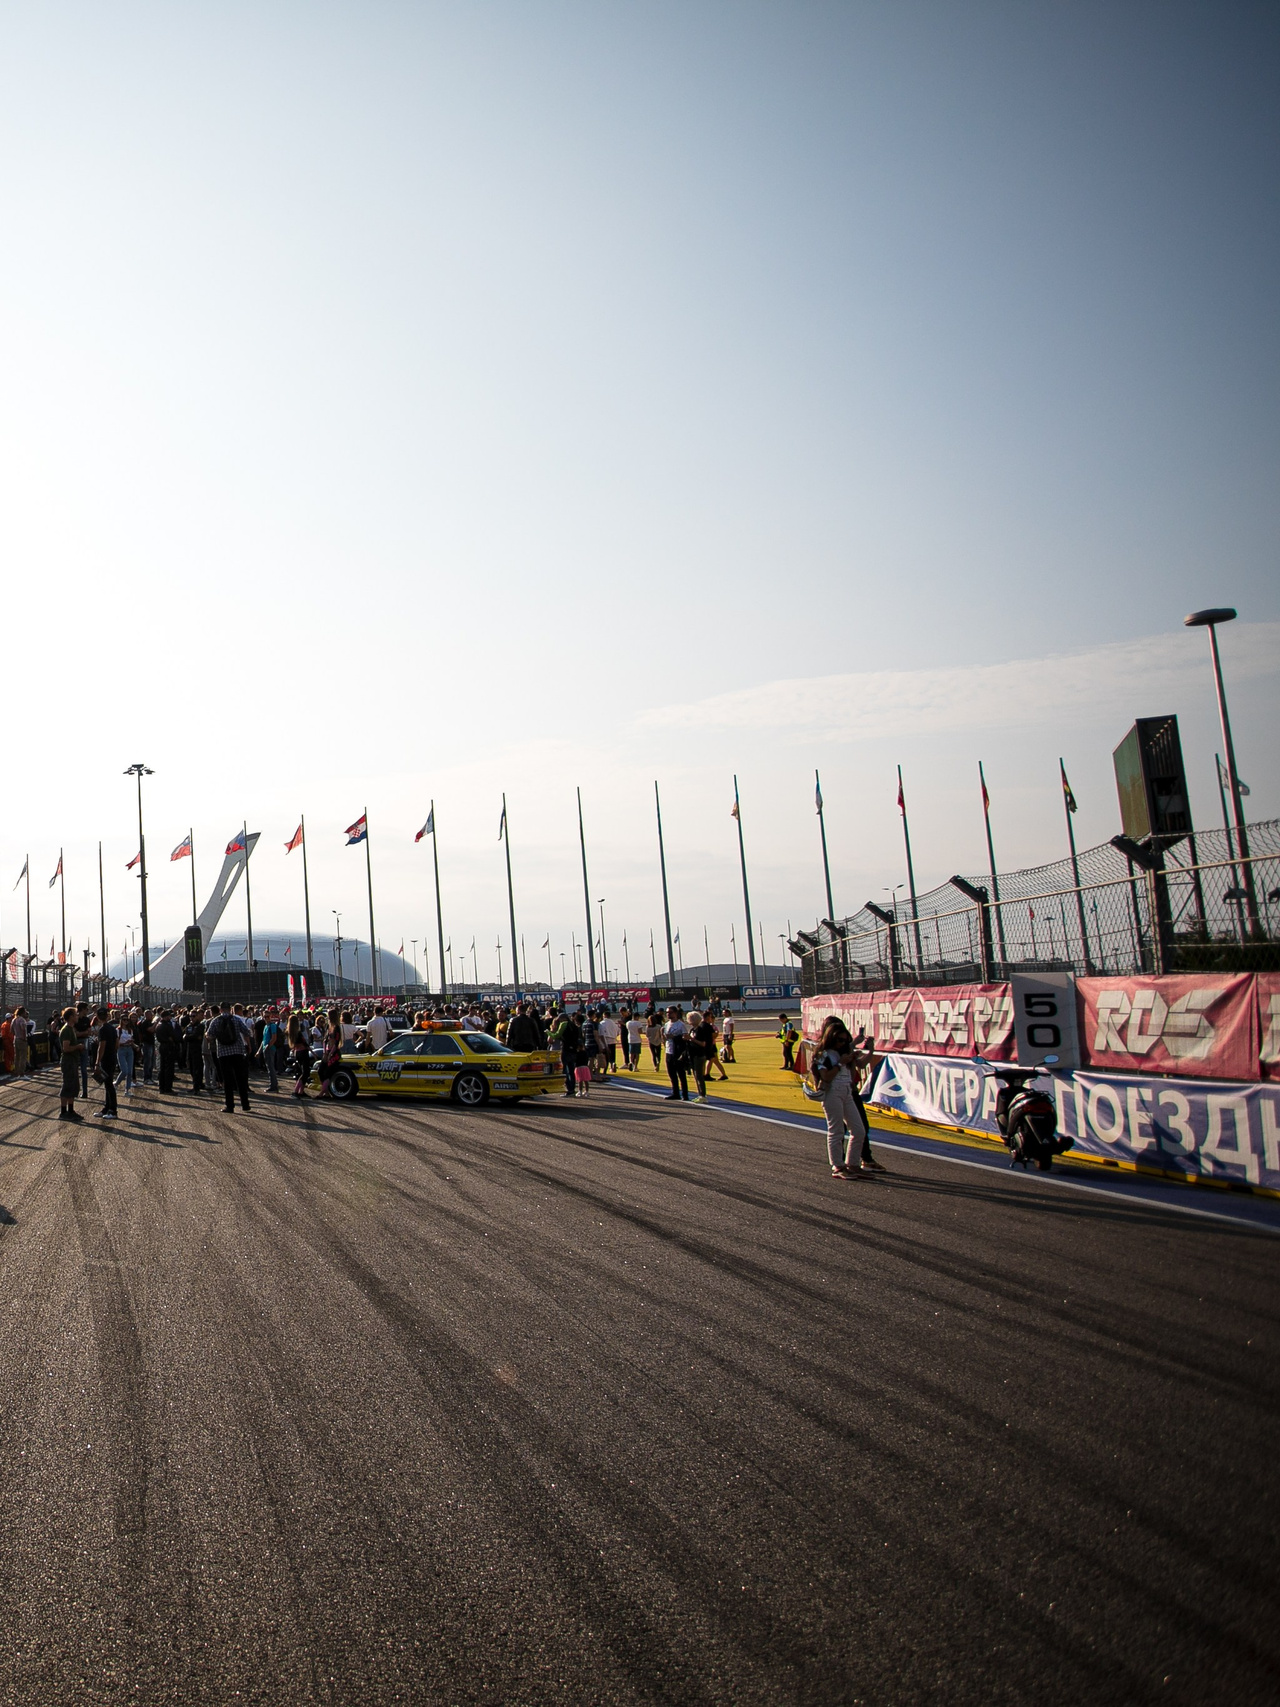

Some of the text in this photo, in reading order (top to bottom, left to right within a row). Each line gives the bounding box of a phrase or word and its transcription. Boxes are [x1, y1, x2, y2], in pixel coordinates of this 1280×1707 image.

[745, 988, 781, 996] AIMOL
[973, 996, 1015, 1044] RD
[1024, 992, 1061, 1048] 50
[1094, 989, 1223, 1057] RDS
[375, 1061, 405, 1072] DRIFT
[379, 1071, 399, 1080] TAXI
